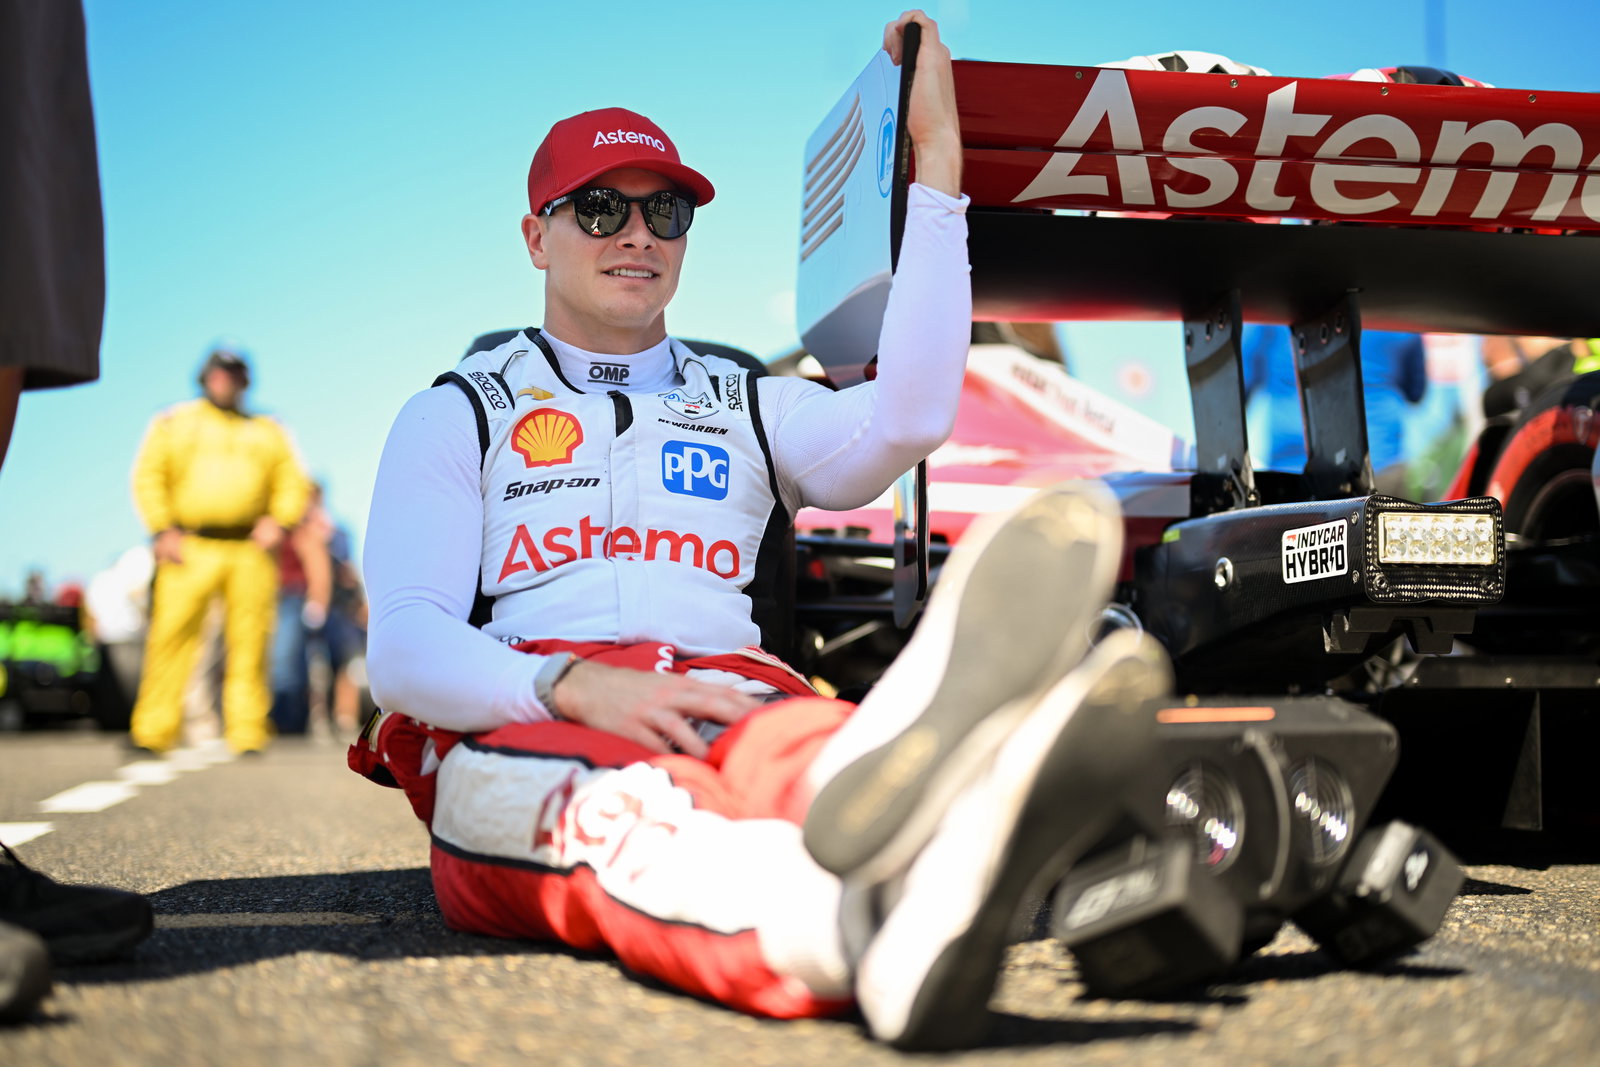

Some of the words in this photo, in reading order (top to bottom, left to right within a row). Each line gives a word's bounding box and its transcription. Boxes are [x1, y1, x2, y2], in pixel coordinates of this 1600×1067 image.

[593, 129, 666, 152] Astemo
[1009, 69, 1600, 221] Astem
[588, 365, 630, 382] OMP
[469, 371, 507, 410] sparco
[664, 446, 728, 492] PPG
[503, 477, 601, 502] Snap-on
[497, 514, 741, 585] Astemo
[1297, 524, 1345, 550] INDYCAR
